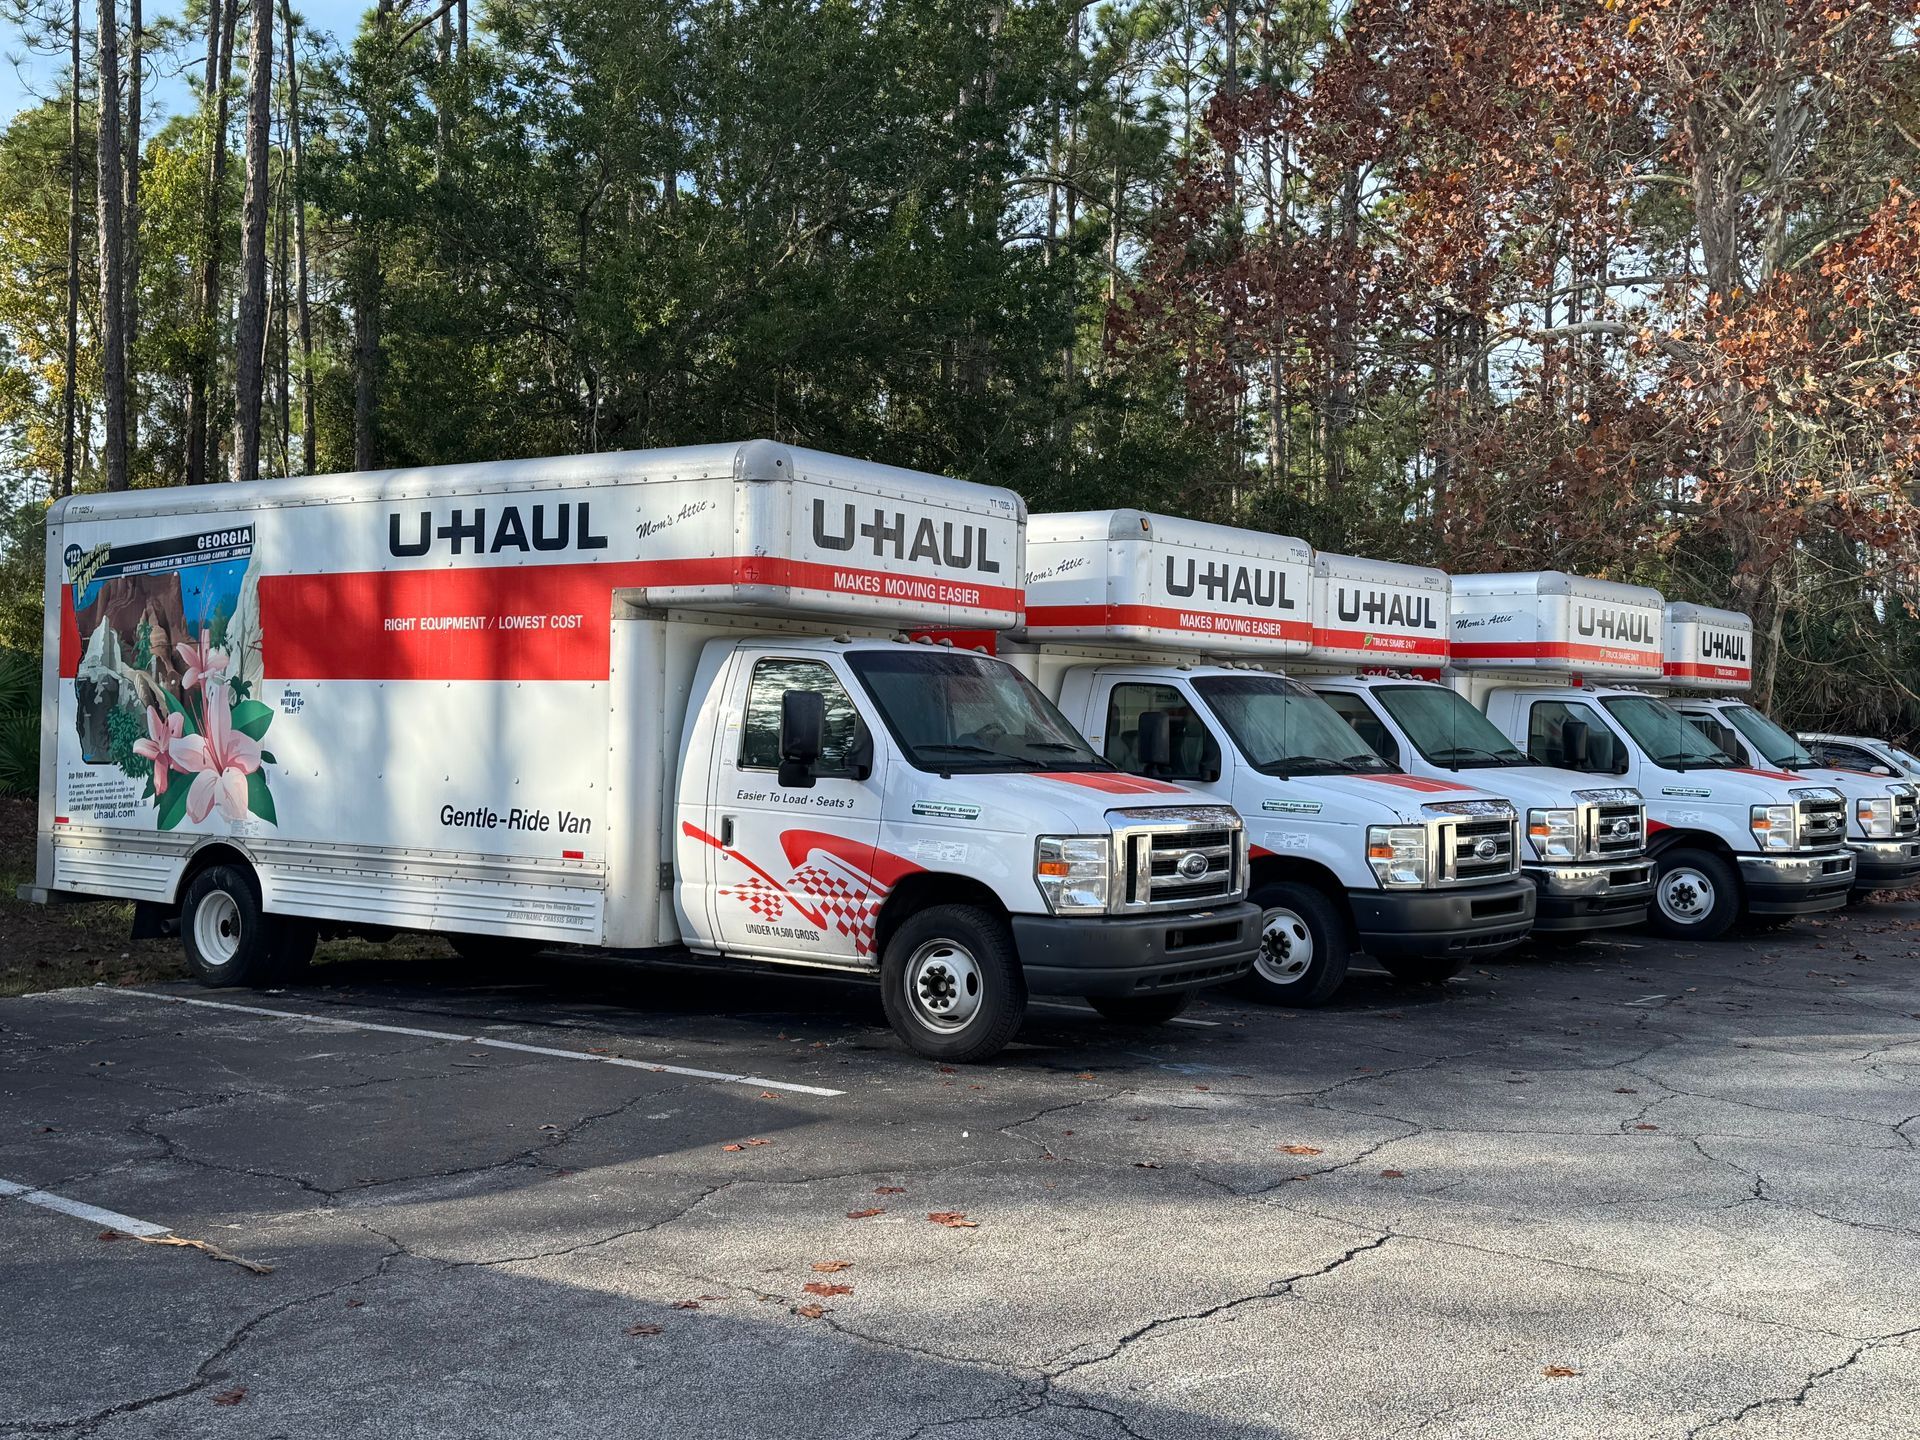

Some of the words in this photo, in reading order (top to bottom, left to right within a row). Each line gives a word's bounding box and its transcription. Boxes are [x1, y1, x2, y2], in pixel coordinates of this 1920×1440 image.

[389, 502, 608, 557] U-HAUL
[636, 514, 673, 539] Mom's
[676, 501, 708, 523] Attic
[197, 529, 250, 550] GEORGIA
[812, 498, 1000, 574] U-HAUL
[66, 549, 80, 563] #122
[1056, 558, 1084, 574] Attic
[834, 572, 880, 592] MAKES
[885, 577, 936, 599] MOVING
[940, 585, 980, 604] EASIER
[1166, 556, 1294, 610] U-HAUL
[1338, 588, 1437, 630] U-HAUL
[384, 618, 416, 631] RIGHT
[420, 616, 486, 630] EQUIPMENT
[498, 615, 547, 630] LOWEST
[550, 614, 584, 629] COST
[1180, 613, 1212, 629] MAKES
[1215, 617, 1250, 632] MOVING
[1252, 622, 1281, 636] EASIER
[1456, 618, 1485, 629] Mom's
[1488, 614, 1513, 625] Attic
[1578, 606, 1654, 644] U-HAUL
[1702, 631, 1746, 662] U-HAUL
[284, 689, 300, 698] Where
[291, 698, 297, 708] U
[736, 790, 766, 801] Easier
[770, 792, 780, 802] To
[782, 793, 808, 804] Load
[816, 796, 845, 808] Seats
[846, 798, 854, 809] 3
[917, 803, 942, 811] TRIMLINE
[94, 809, 136, 819] uhaul.com
[440, 804, 550, 832] Gentle-Ride
[558, 810, 592, 834] Van
[506, 912, 542, 921] AERODYNAMIC
[543, 915, 565, 923] CHASSIS
[565, 917, 584, 925] SKIRTS
[746, 924, 771, 936] UNDER
[772, 926, 794, 938] 14,500
[794, 929, 820, 941] GROSS
